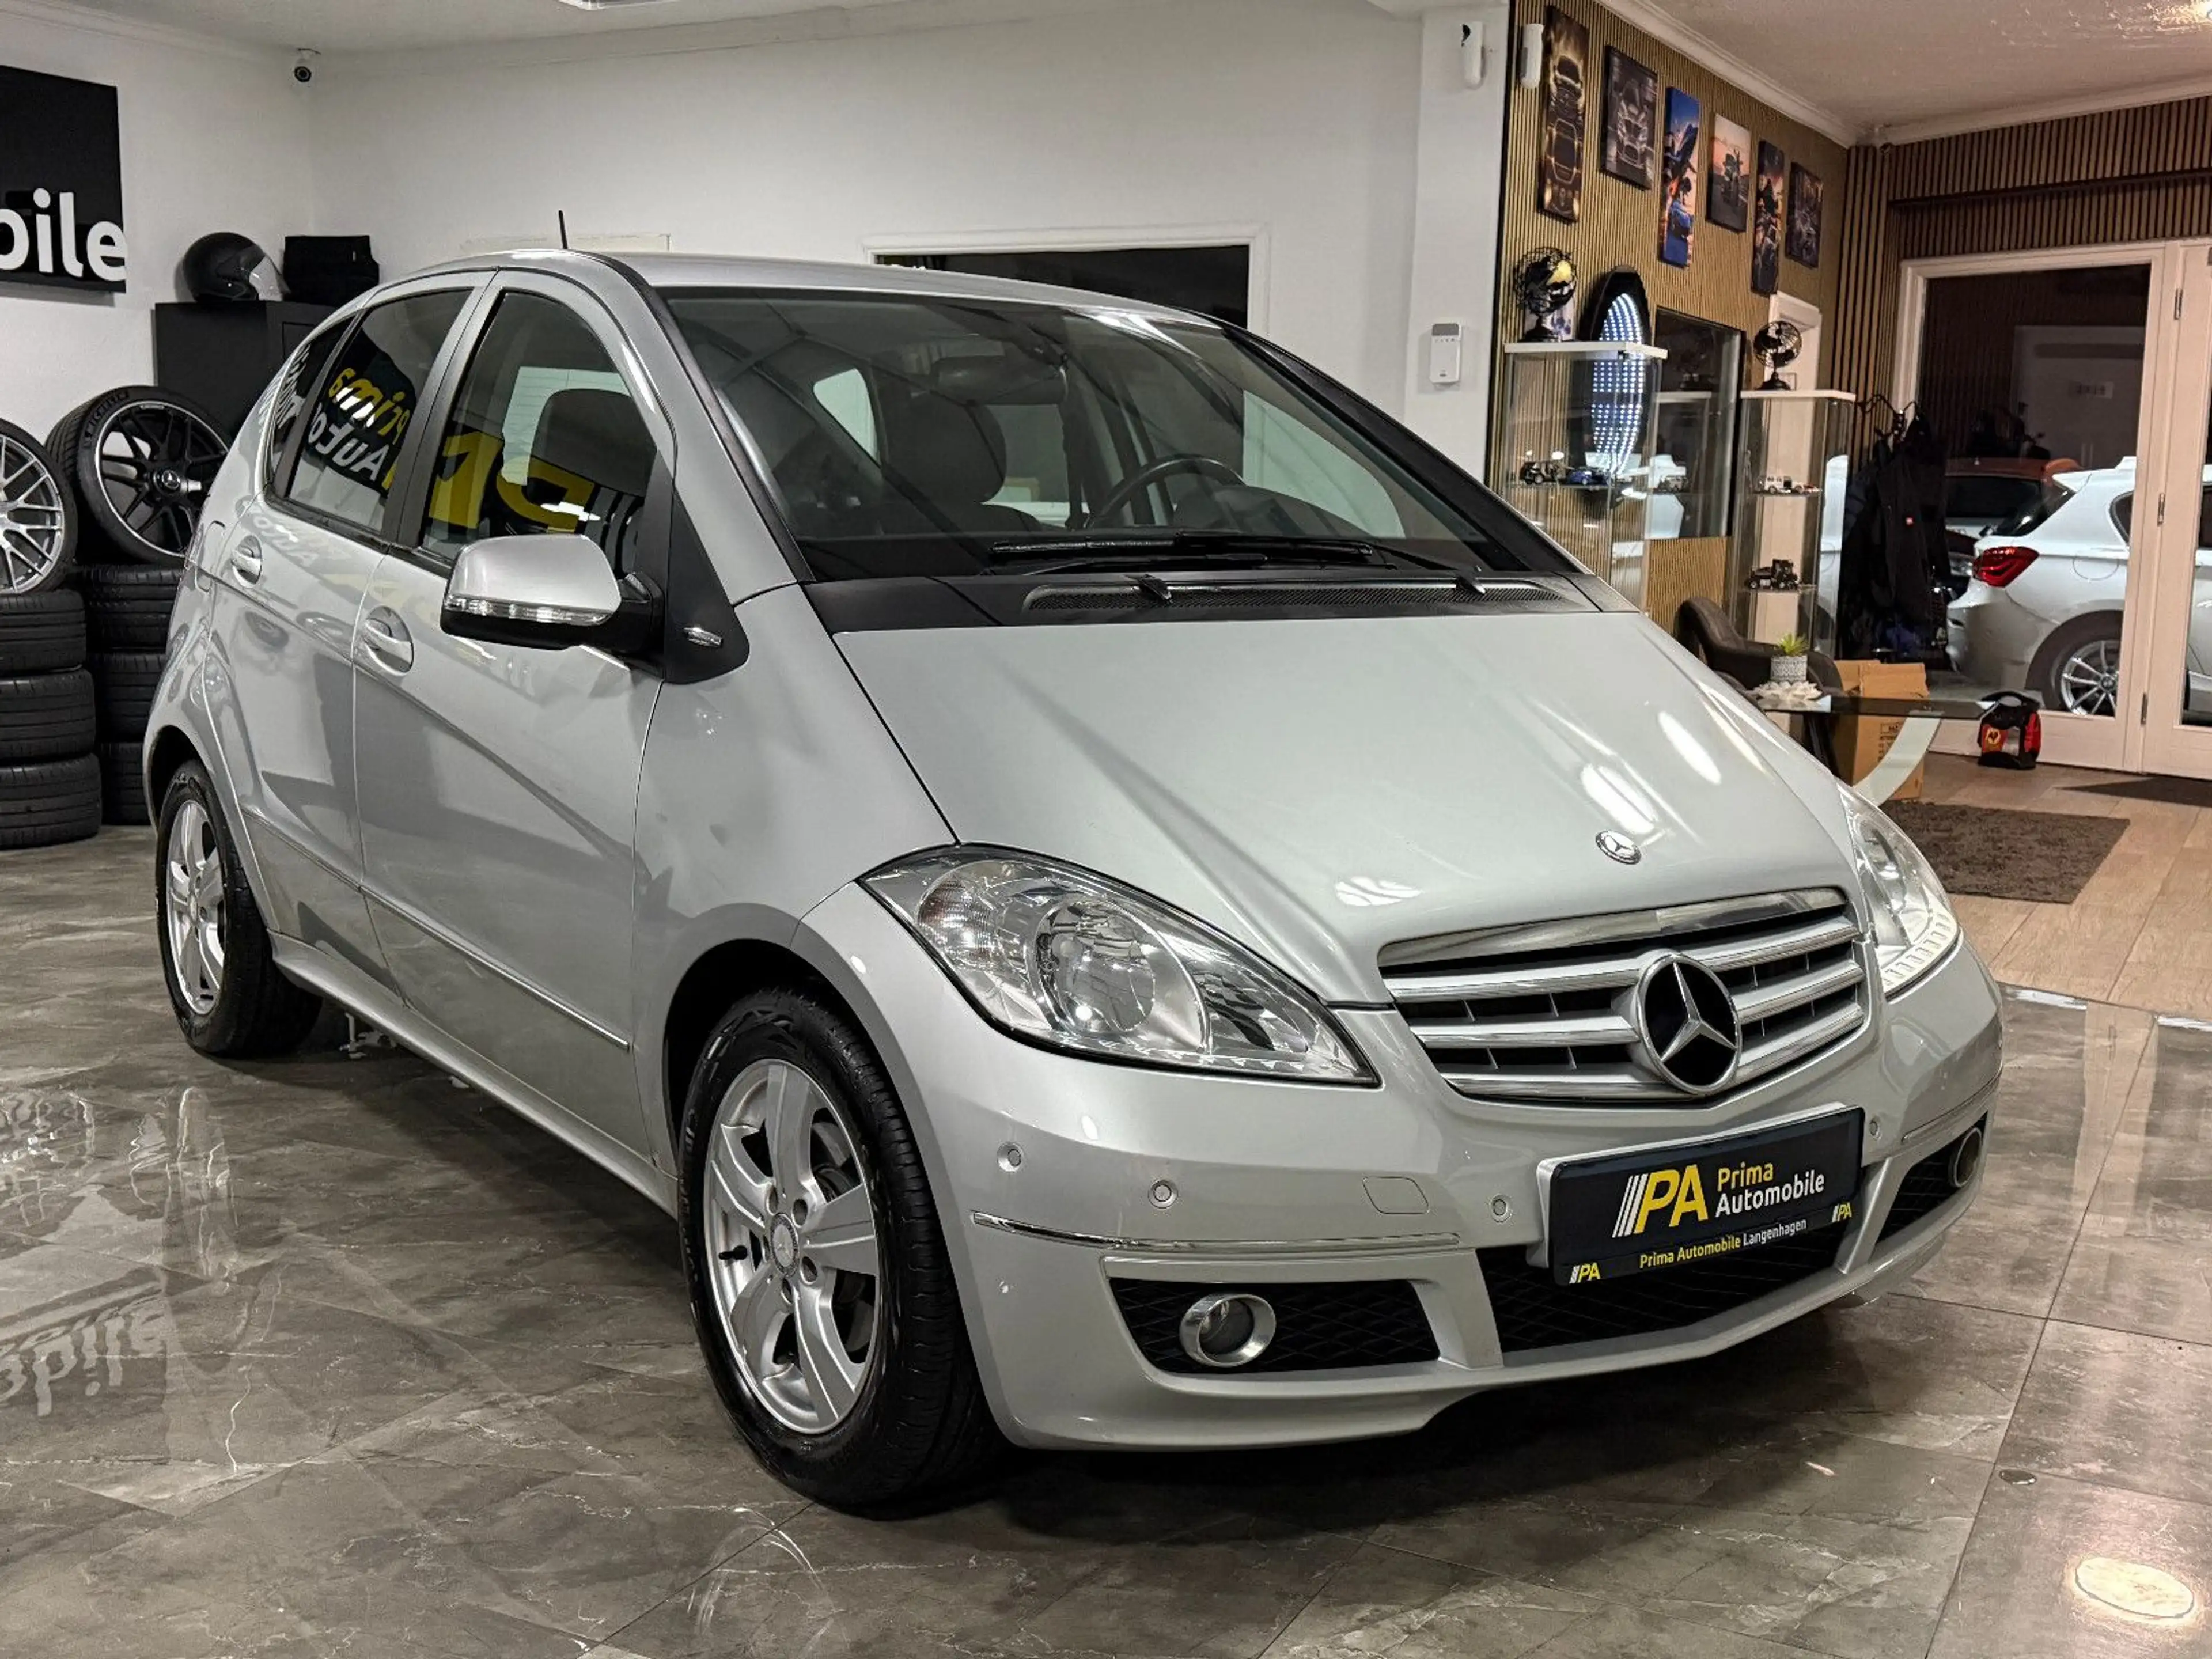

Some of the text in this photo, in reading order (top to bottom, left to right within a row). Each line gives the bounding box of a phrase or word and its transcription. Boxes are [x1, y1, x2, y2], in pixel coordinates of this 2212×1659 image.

[1715, 1169, 1825, 1218] Automobile
[1717, 1161, 1774, 1192] Prima
[1634, 1164, 1708, 1233] PA
[1837, 1202, 1852, 1222] PA
[1639, 1219, 1806, 1268] Prima Automobile Langenhagen
[1577, 1262, 1601, 1283] PA
